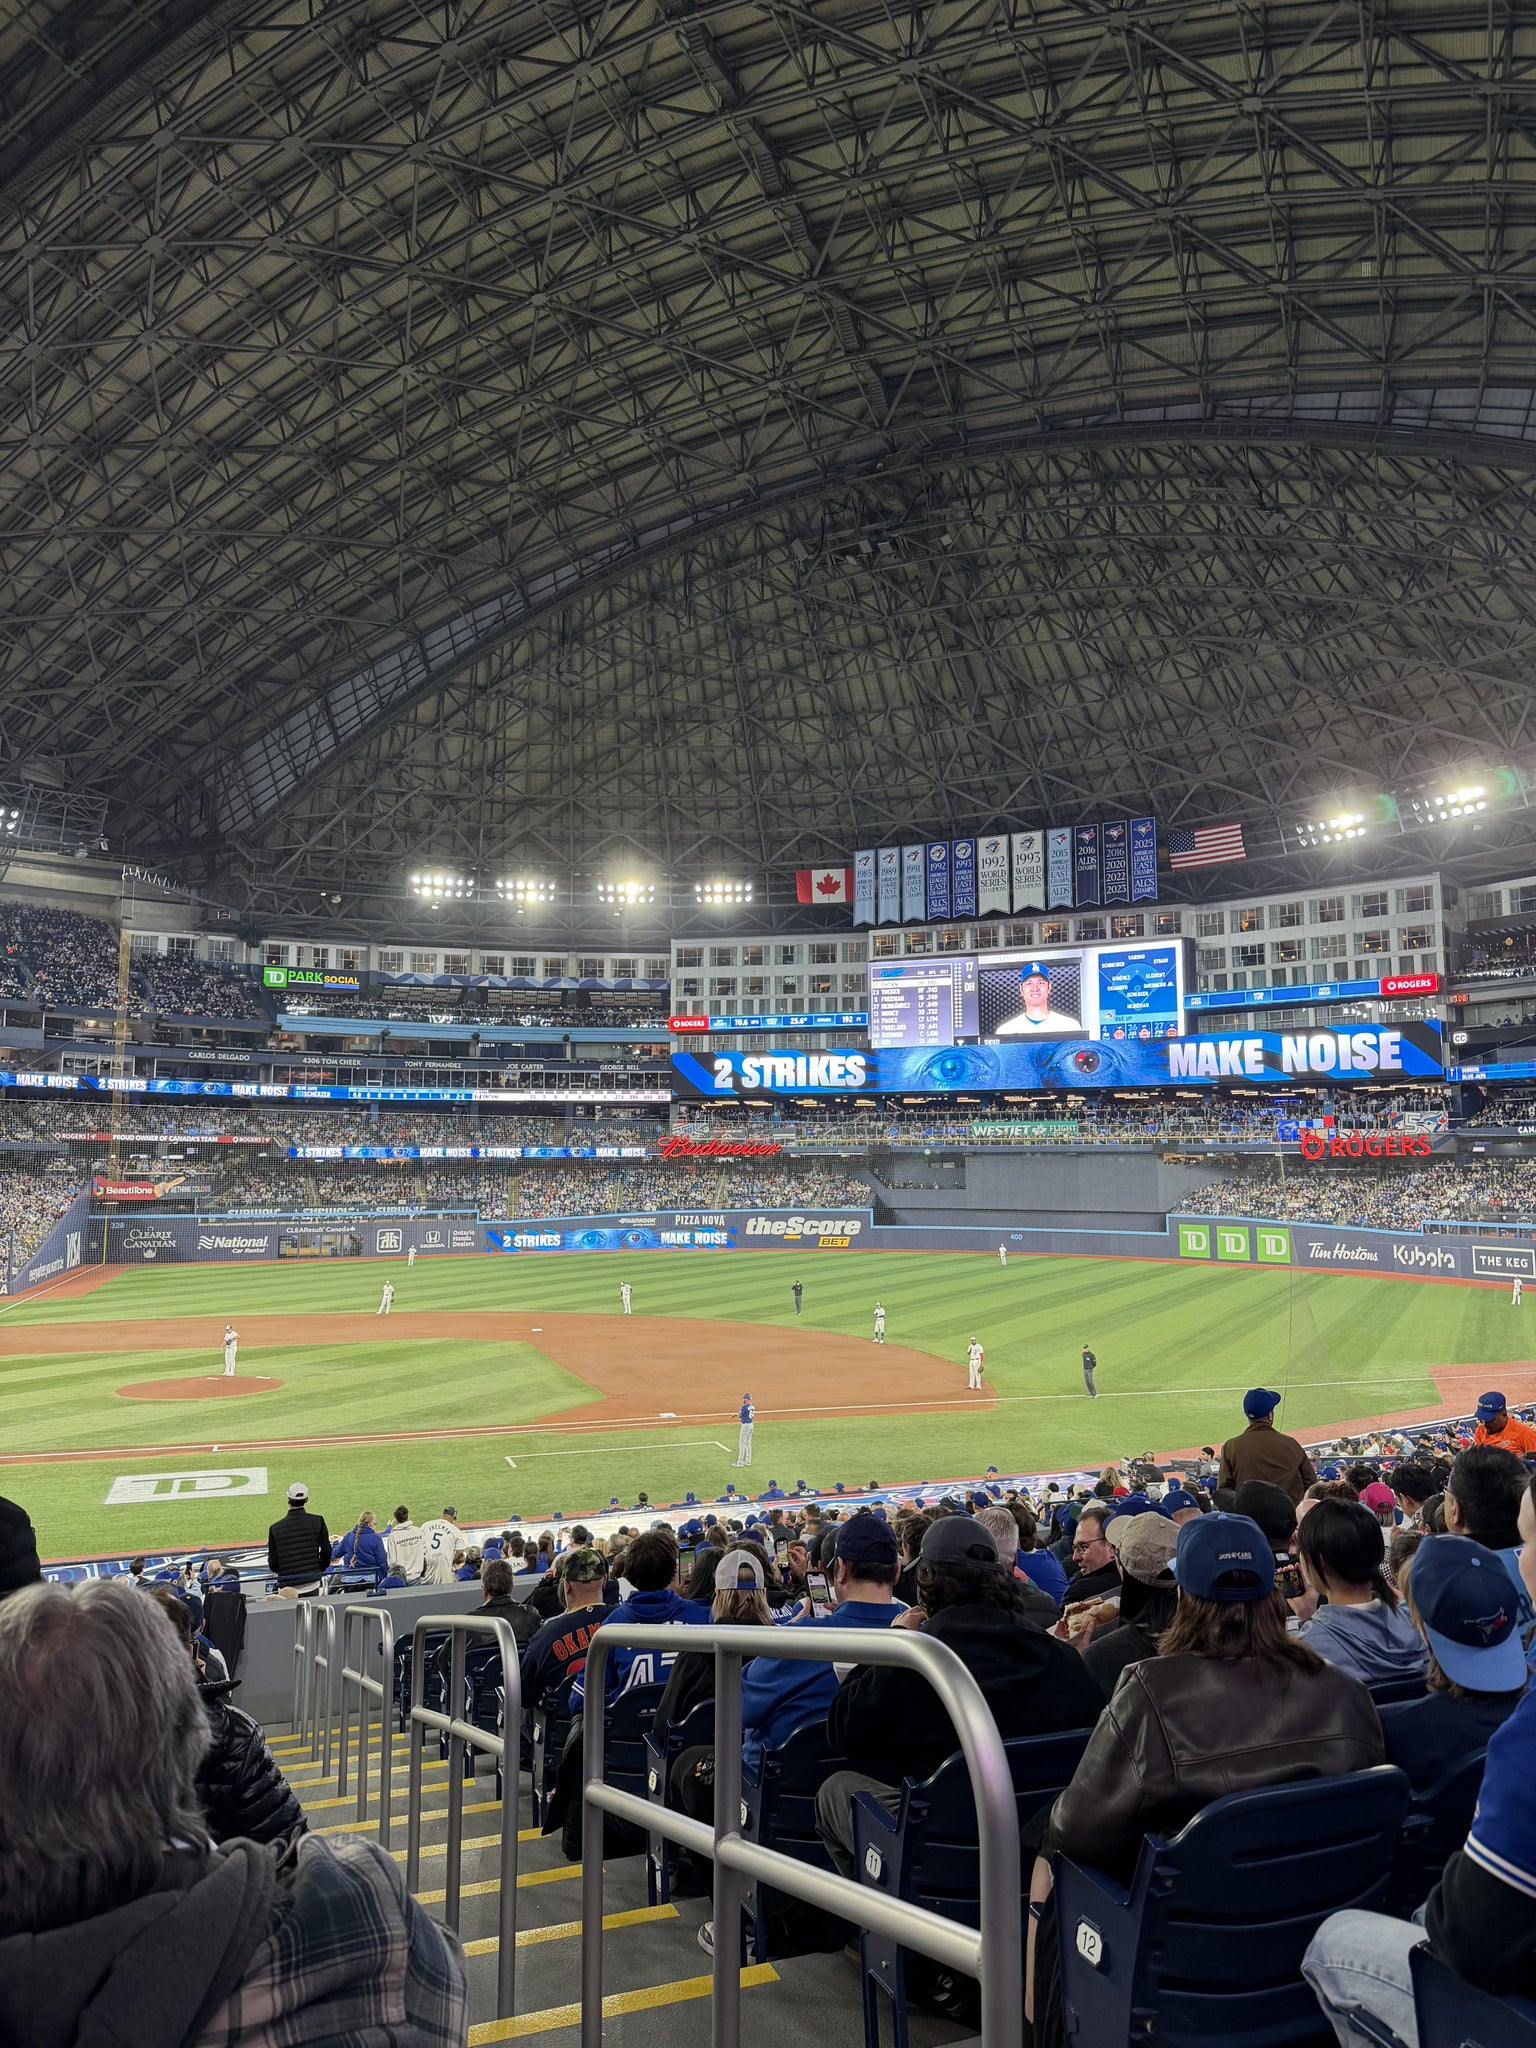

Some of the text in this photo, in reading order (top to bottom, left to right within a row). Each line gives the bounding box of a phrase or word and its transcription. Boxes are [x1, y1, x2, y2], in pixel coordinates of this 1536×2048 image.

[1134, 839, 1154, 848] 2025
[1052, 849, 1068, 858] 2015
[1078, 846, 1096, 855] 2016
[1106, 848, 1124, 857] 2016
[956, 859, 972, 868] 1993
[982, 856, 1005, 869] 1992
[1016, 852, 1040, 865] 1993
[1078, 856, 1096, 865] ALDS
[930, 863, 946, 871] 1992
[1106, 860, 1125, 870] 2020
[1134, 861, 1153, 869] EAST
[981, 869, 1006, 879] WORLD
[1015, 866, 1041, 875] WORLD
[1015, 874, 1041, 884] SERIES
[1106, 872, 1126, 881] 2022
[980, 878, 1006, 887] SERIES
[1135, 878, 1155, 888] ALCS
[930, 898, 947, 907] ALCS
[956, 896, 973, 904] ALCS
[965, 962, 974, 971] 17
[267, 971, 359, 984] TD PARK SOCIAL
[964, 982, 975, 991] DH
[1398, 980, 1431, 988] ROGERS
[189, 1052, 250, 1061] CARLOS DELGADO
[1169, 1032, 1402, 1078] MAKE NOISE
[714, 1055, 865, 1089] 2 STRIKES
[16, 1074, 78, 1087] MAKE NOISE
[98, 1079, 147, 1090] 2 STRIKES
[232, 1084, 288, 1096] MAKE NOISE
[973, 1125, 1031, 1137] WESTJET
[657, 1136, 781, 1158] Budweiser
[1331, 1136, 1431, 1157] ROGERS
[297, 1148, 342, 1157] 2 STRIKES
[420, 1148, 471, 1157] MAKE NOISE
[479, 1148, 522, 1157] 2 STRIKES
[595, 1147, 647, 1157] MAKE NOISE
[106, 1186, 153, 1195] BeautiTone
[675, 1215, 725, 1225] PIZZA NOVA
[746, 1217, 861, 1235] theScore
[214, 1236, 266, 1248] National
[503, 1235, 560, 1247] 2 STRIKES
[661, 1232, 727, 1243] MAKE NOISE
[1182, 1232, 1207, 1251] TD
[124, 1238, 176, 1248] CANADIAN
[1220, 1233, 1246, 1253] TD
[1260, 1234, 1287, 1255] TD
[67, 1231, 81, 1268] VISA
[1309, 1242, 1379, 1262] Tim Hortons
[1394, 1245, 1455, 1269] Kubota
[1480, 1255, 1529, 1268] THE KEG
[131, 1475, 250, 1495] TD
[431, 1532, 443, 1549] 5
[870, 1854, 877, 1872] 11
[1083, 1930, 1095, 1958] 12
